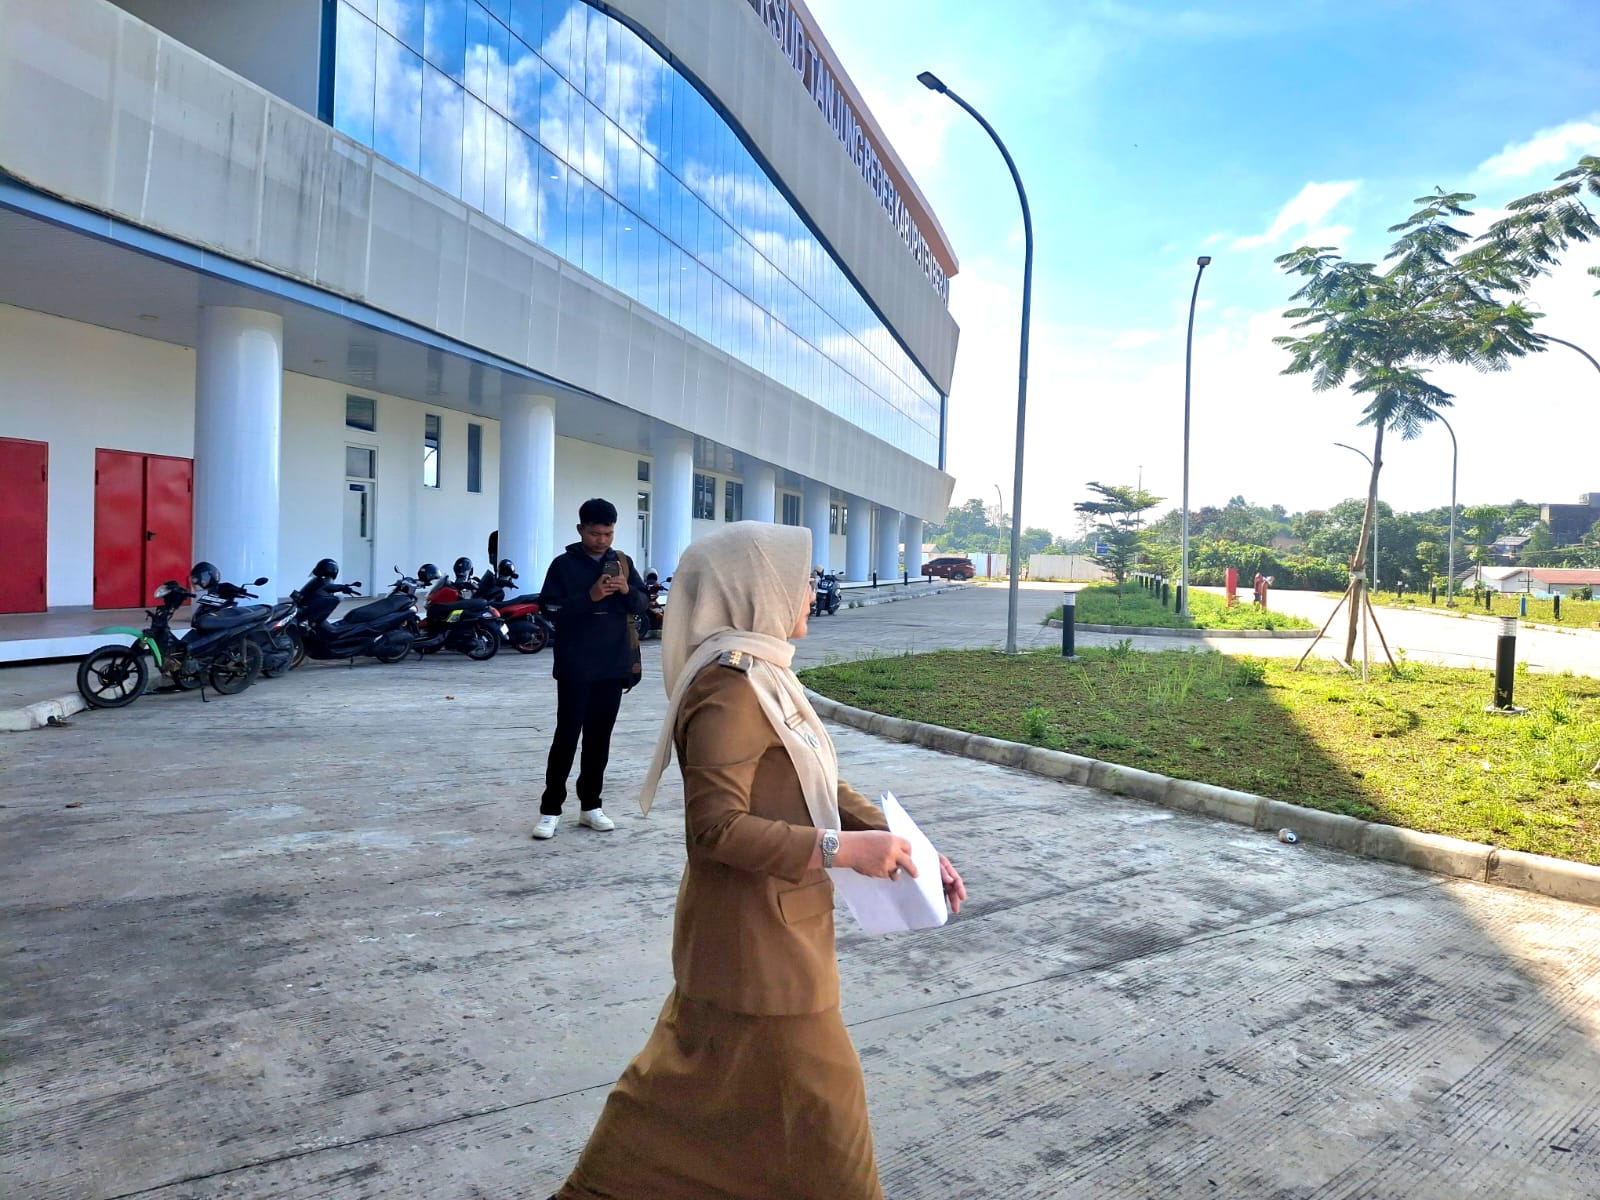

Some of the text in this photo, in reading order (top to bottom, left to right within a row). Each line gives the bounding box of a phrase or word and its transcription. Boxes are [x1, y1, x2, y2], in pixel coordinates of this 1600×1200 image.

[808, 39, 864, 168] TANJUNG
[864, 136, 894, 224] REDEB
[895, 190, 933, 284] KABUPATEN
